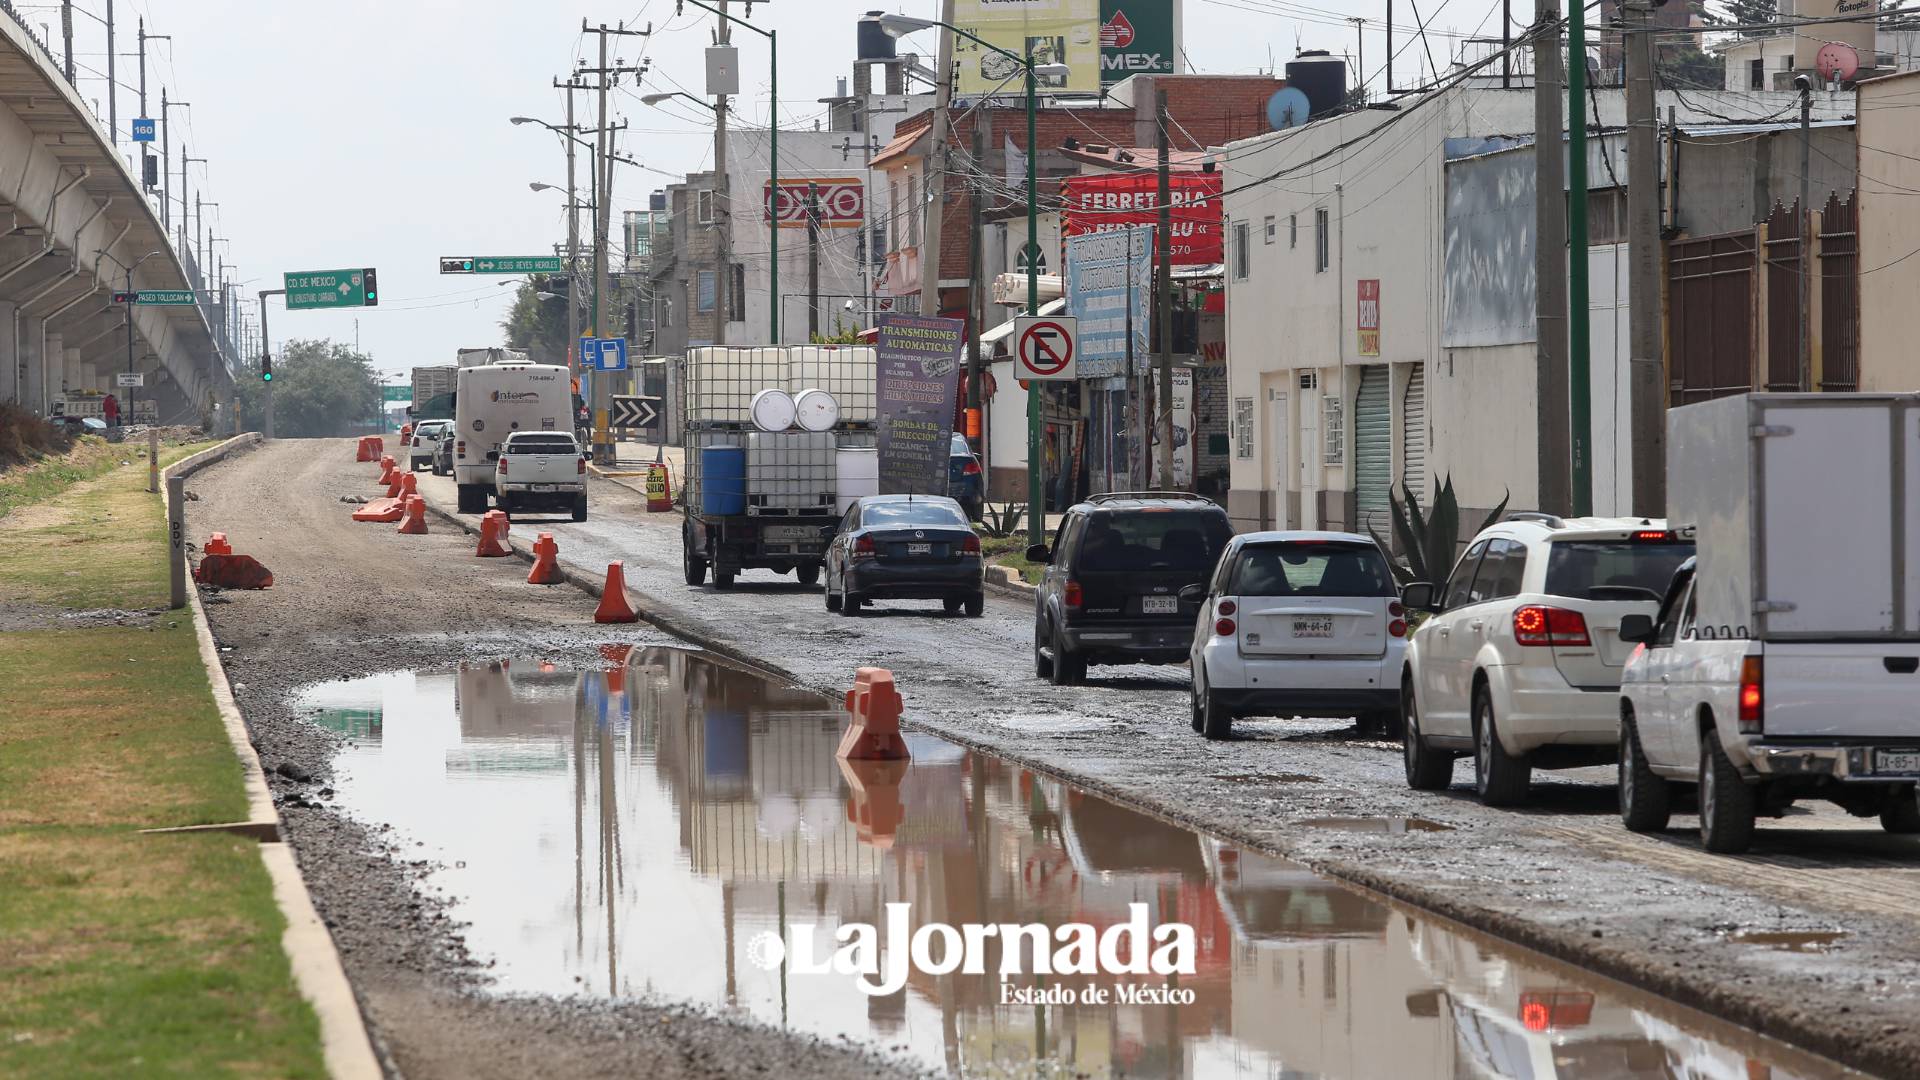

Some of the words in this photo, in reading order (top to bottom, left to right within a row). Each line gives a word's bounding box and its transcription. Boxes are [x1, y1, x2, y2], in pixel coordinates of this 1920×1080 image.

[134, 126, 153, 134] 160
[766, 185, 861, 220] OXXO
[1081, 187, 1208, 209] FERRETRÍA
[497, 262, 514, 270] JESUS
[515, 261, 533, 270] REYES
[300, 278, 309, 287] DE
[311, 276, 336, 287] MEXICO
[882, 325, 958, 340] TRANSMISIONES
[893, 419, 926, 430] BOMBAS
[927, 422, 939, 431] DE
